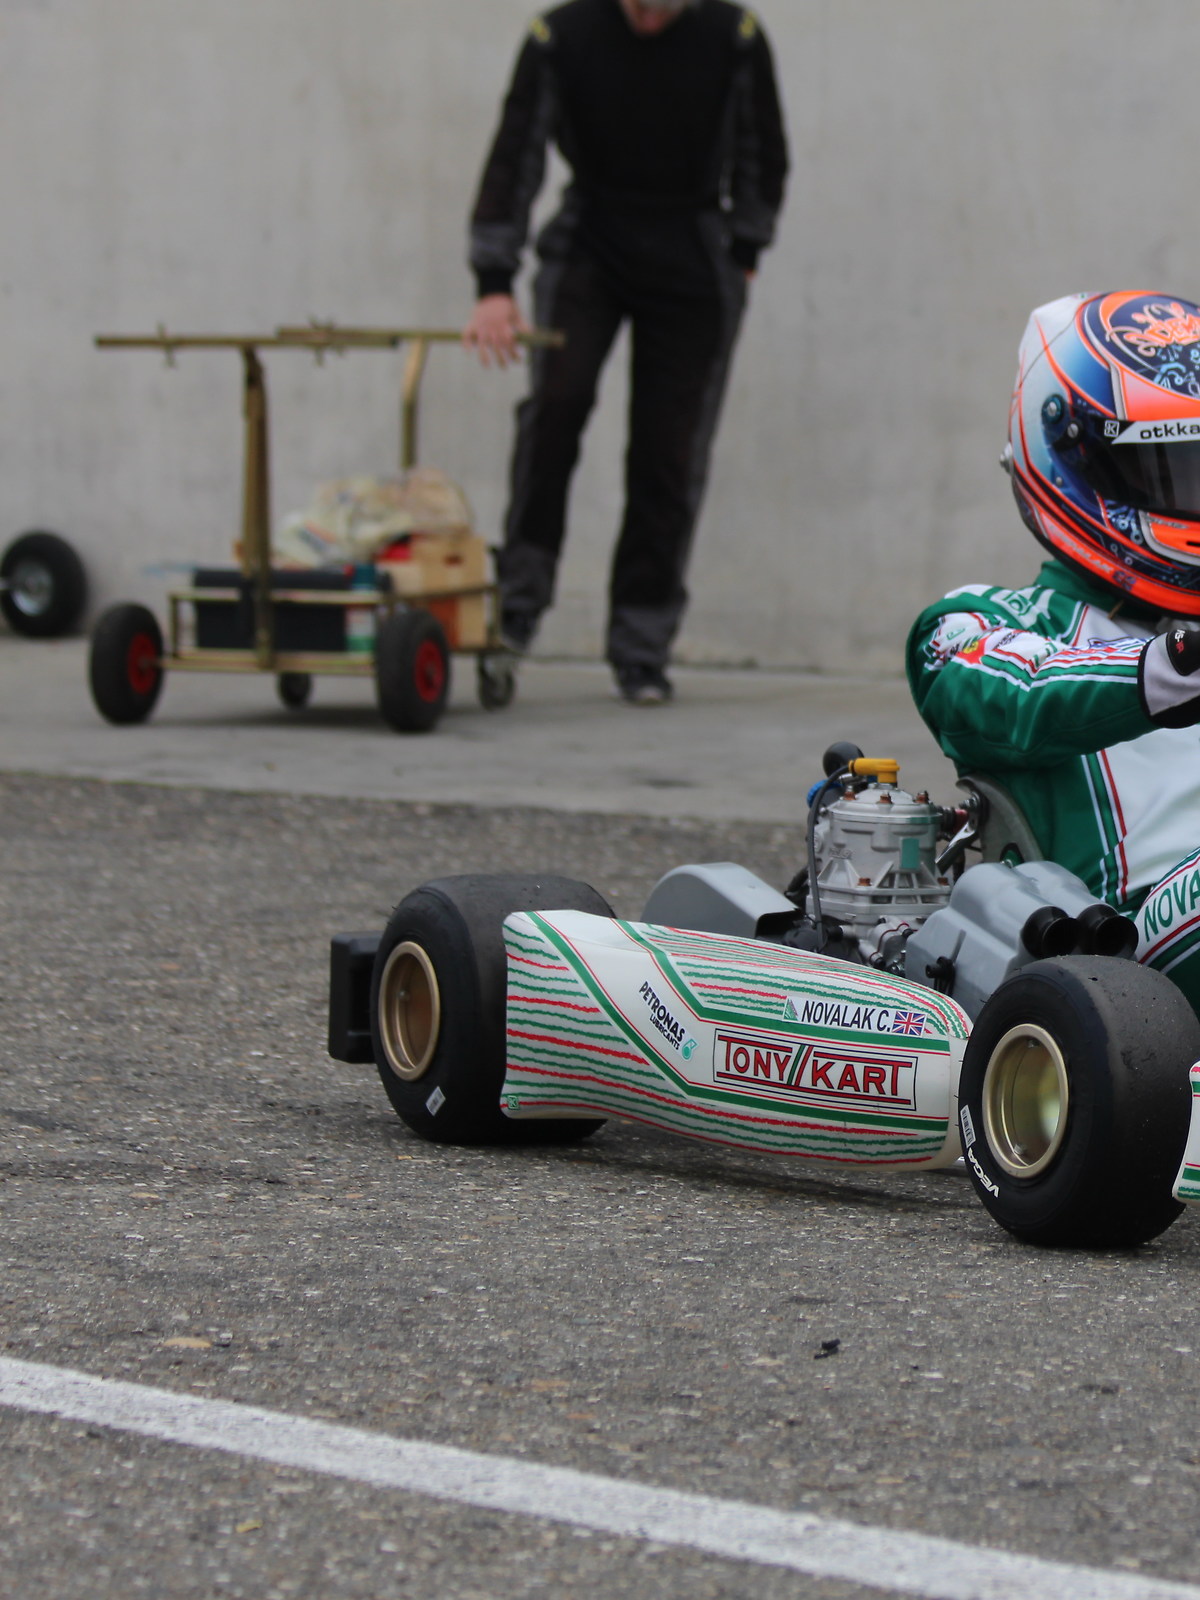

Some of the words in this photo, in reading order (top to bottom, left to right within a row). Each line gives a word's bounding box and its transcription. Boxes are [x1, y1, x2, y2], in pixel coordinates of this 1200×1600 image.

[639, 981, 685, 1042] PETRONAS
[801, 1000, 877, 1031] NOVALAK
[877, 1012, 891, 1032] C.
[650, 1014, 680, 1050] LUBRICANTS
